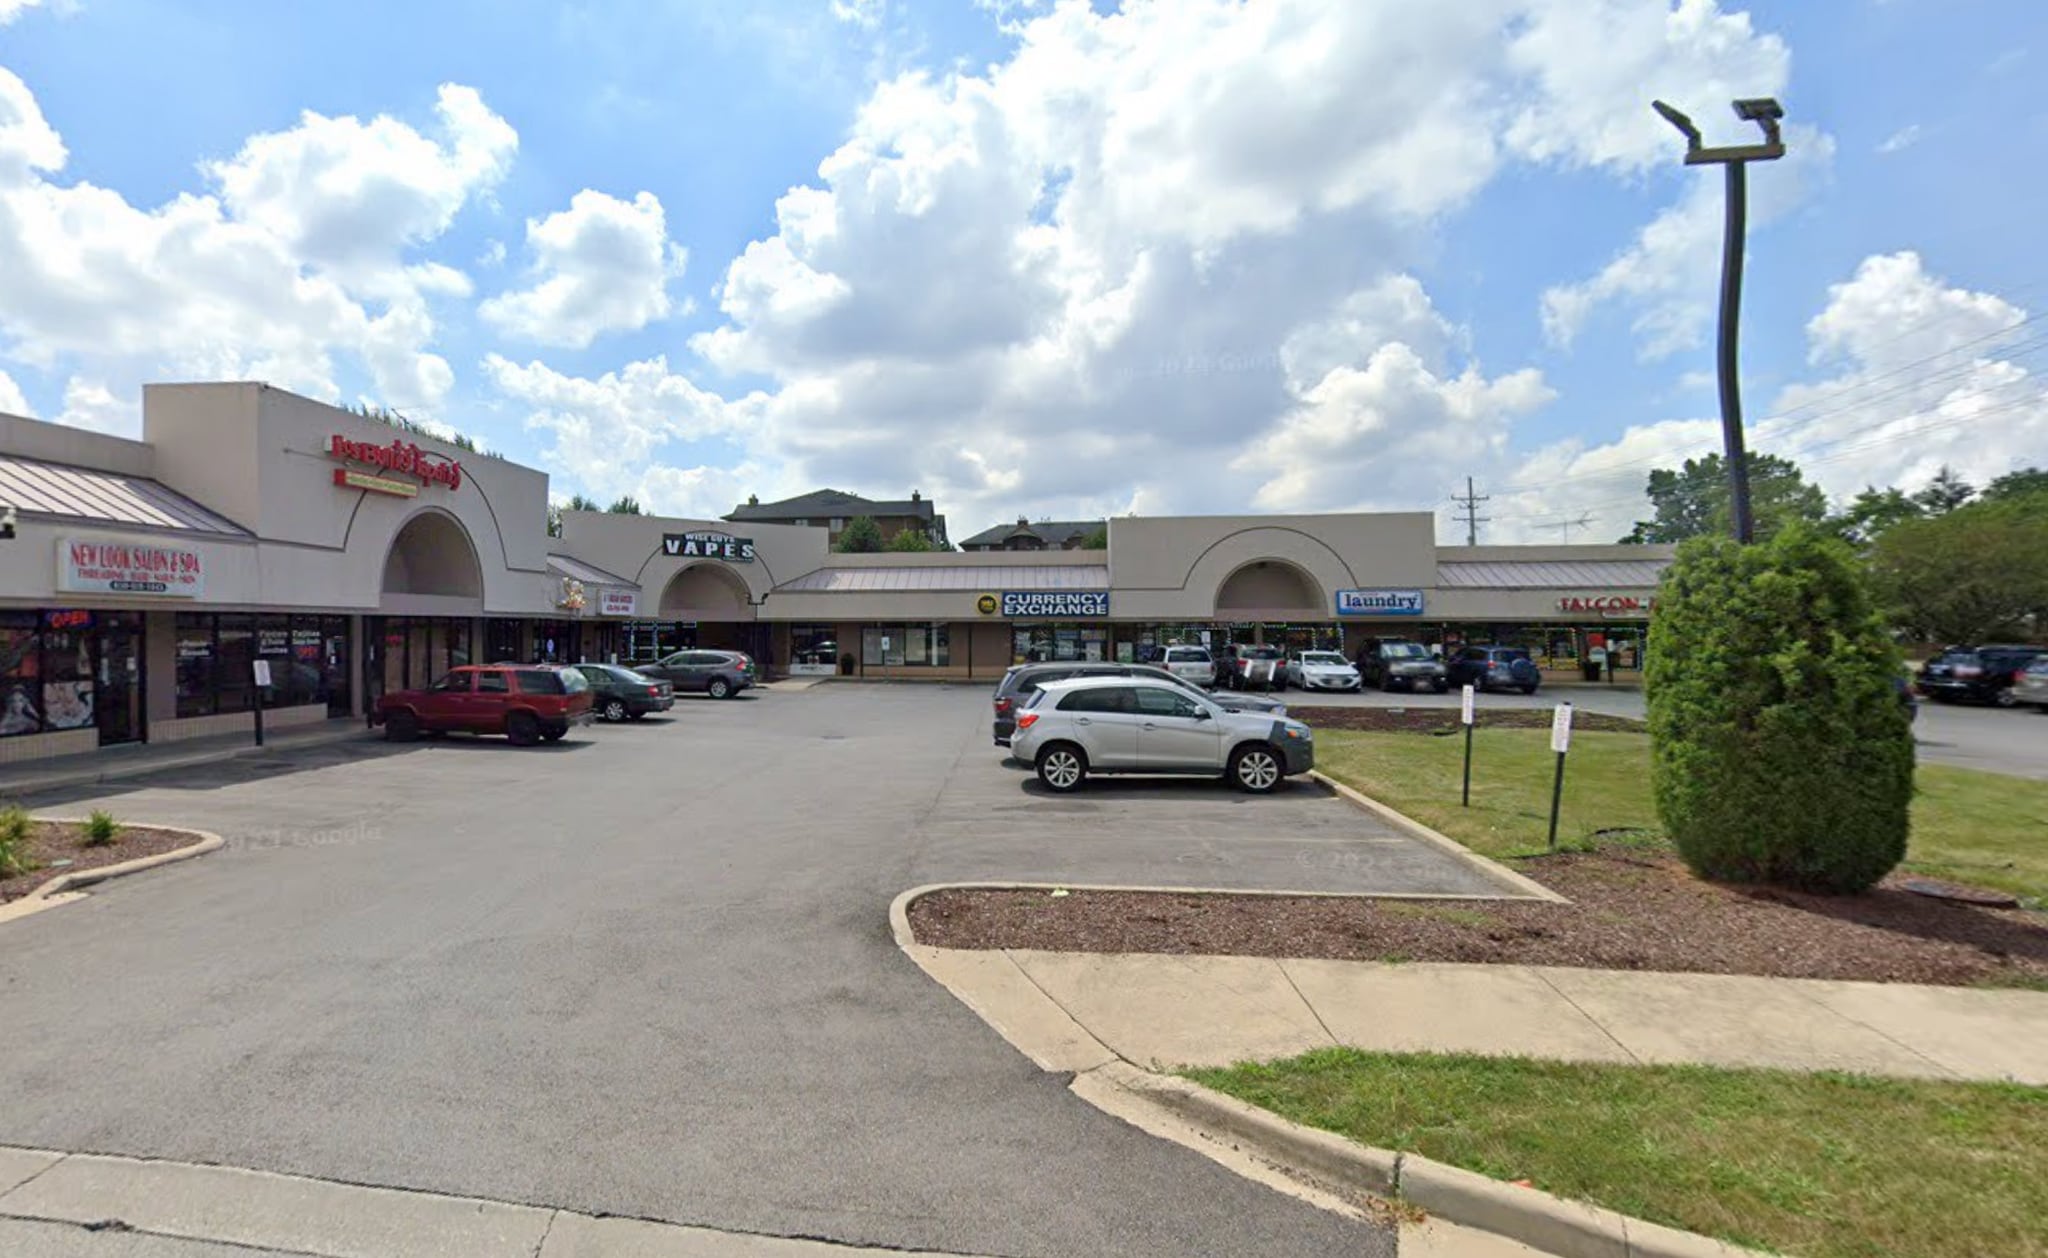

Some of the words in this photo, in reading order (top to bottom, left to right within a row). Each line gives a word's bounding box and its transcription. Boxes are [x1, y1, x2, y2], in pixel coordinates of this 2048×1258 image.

[666, 539, 753, 558] VAPES
[71, 544, 98, 566] NEW
[101, 545, 131, 569] LOOK
[134, 548, 168, 571] SALON
[180, 552, 200, 573] SPA
[1004, 594, 1106, 605] CURRENCY
[1344, 593, 1418, 610] laundry
[1004, 604, 1107, 615] EXCHANGE
